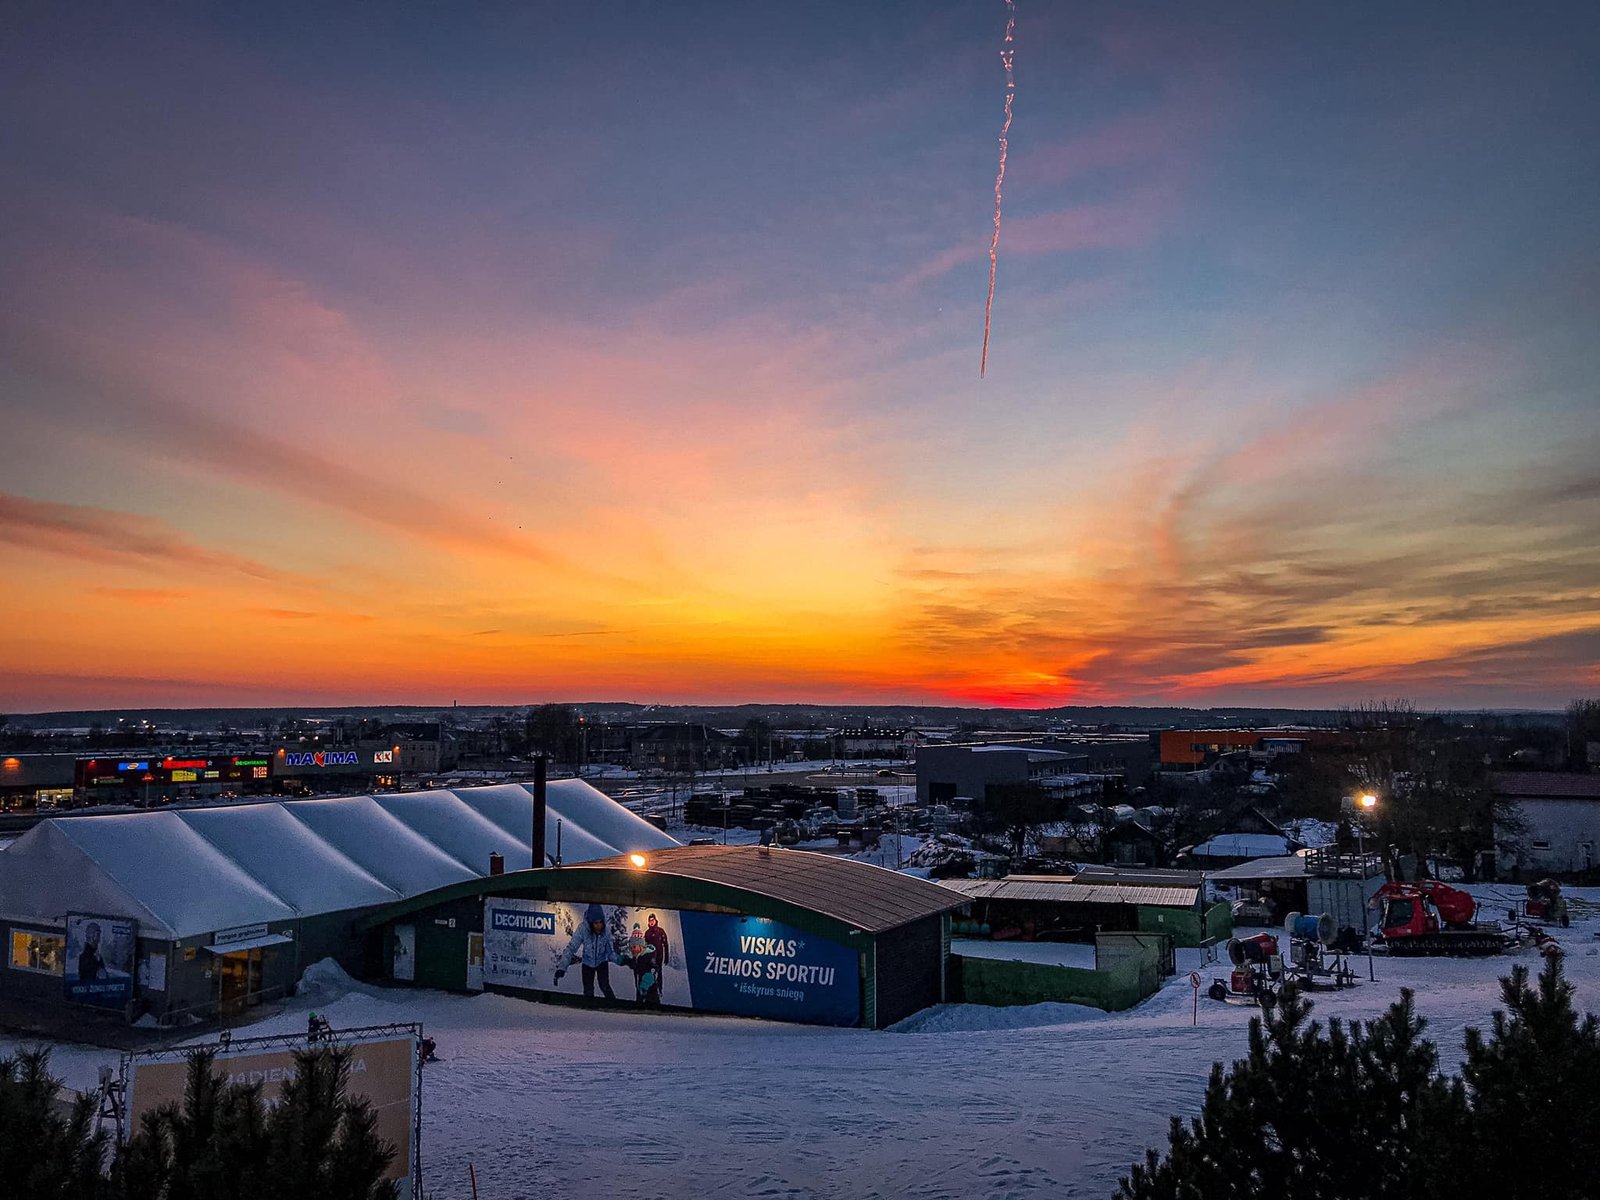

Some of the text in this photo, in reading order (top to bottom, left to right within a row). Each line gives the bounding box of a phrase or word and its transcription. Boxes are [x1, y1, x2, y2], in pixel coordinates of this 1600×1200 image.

[286, 751, 359, 767] MAXIMA
[495, 913, 552, 930] DECATHLON
[704, 952, 834, 986] ŽIEMOS SPORTUI
[740, 982, 774, 997] išskyrus
[776, 987, 804, 1001] sniegą
